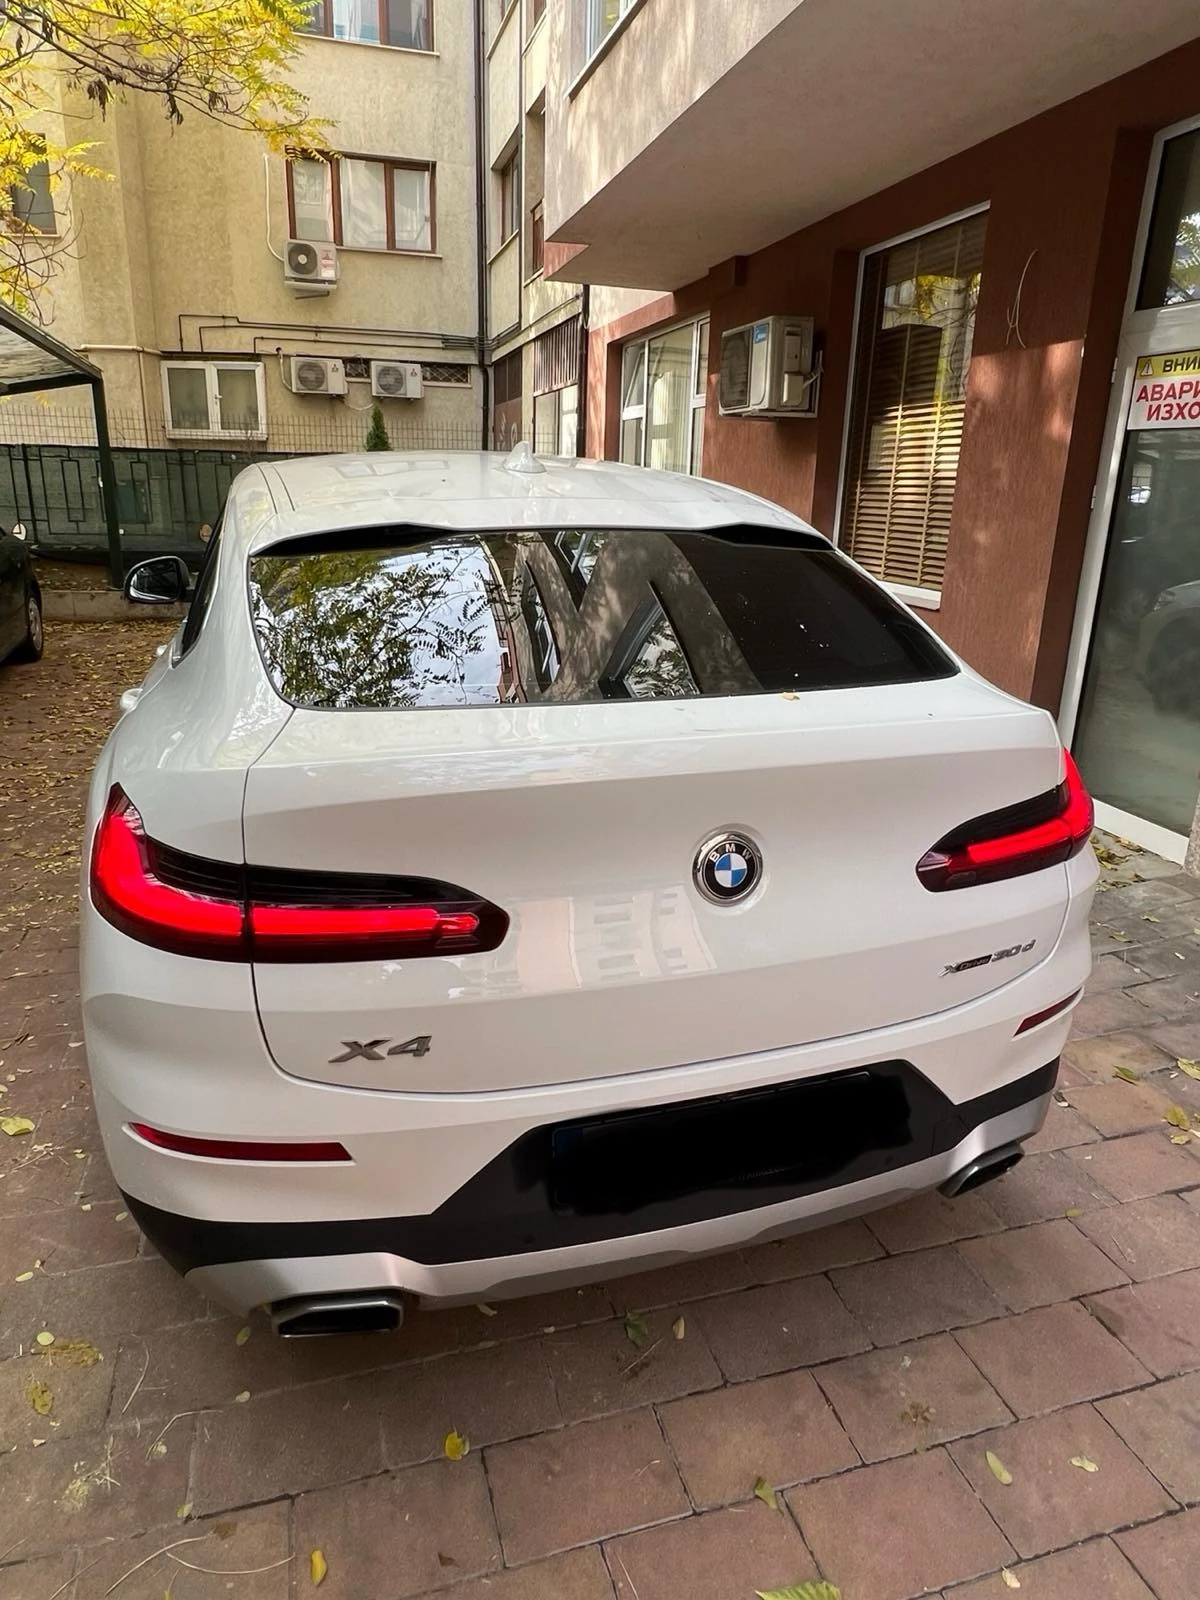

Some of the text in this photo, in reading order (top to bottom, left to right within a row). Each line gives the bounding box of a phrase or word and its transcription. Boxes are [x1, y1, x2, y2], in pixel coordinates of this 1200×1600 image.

[1163, 356, 1200, 373] ВНИ
[709, 843, 752, 862] BMW
[328, 1035, 432, 1063] X4
